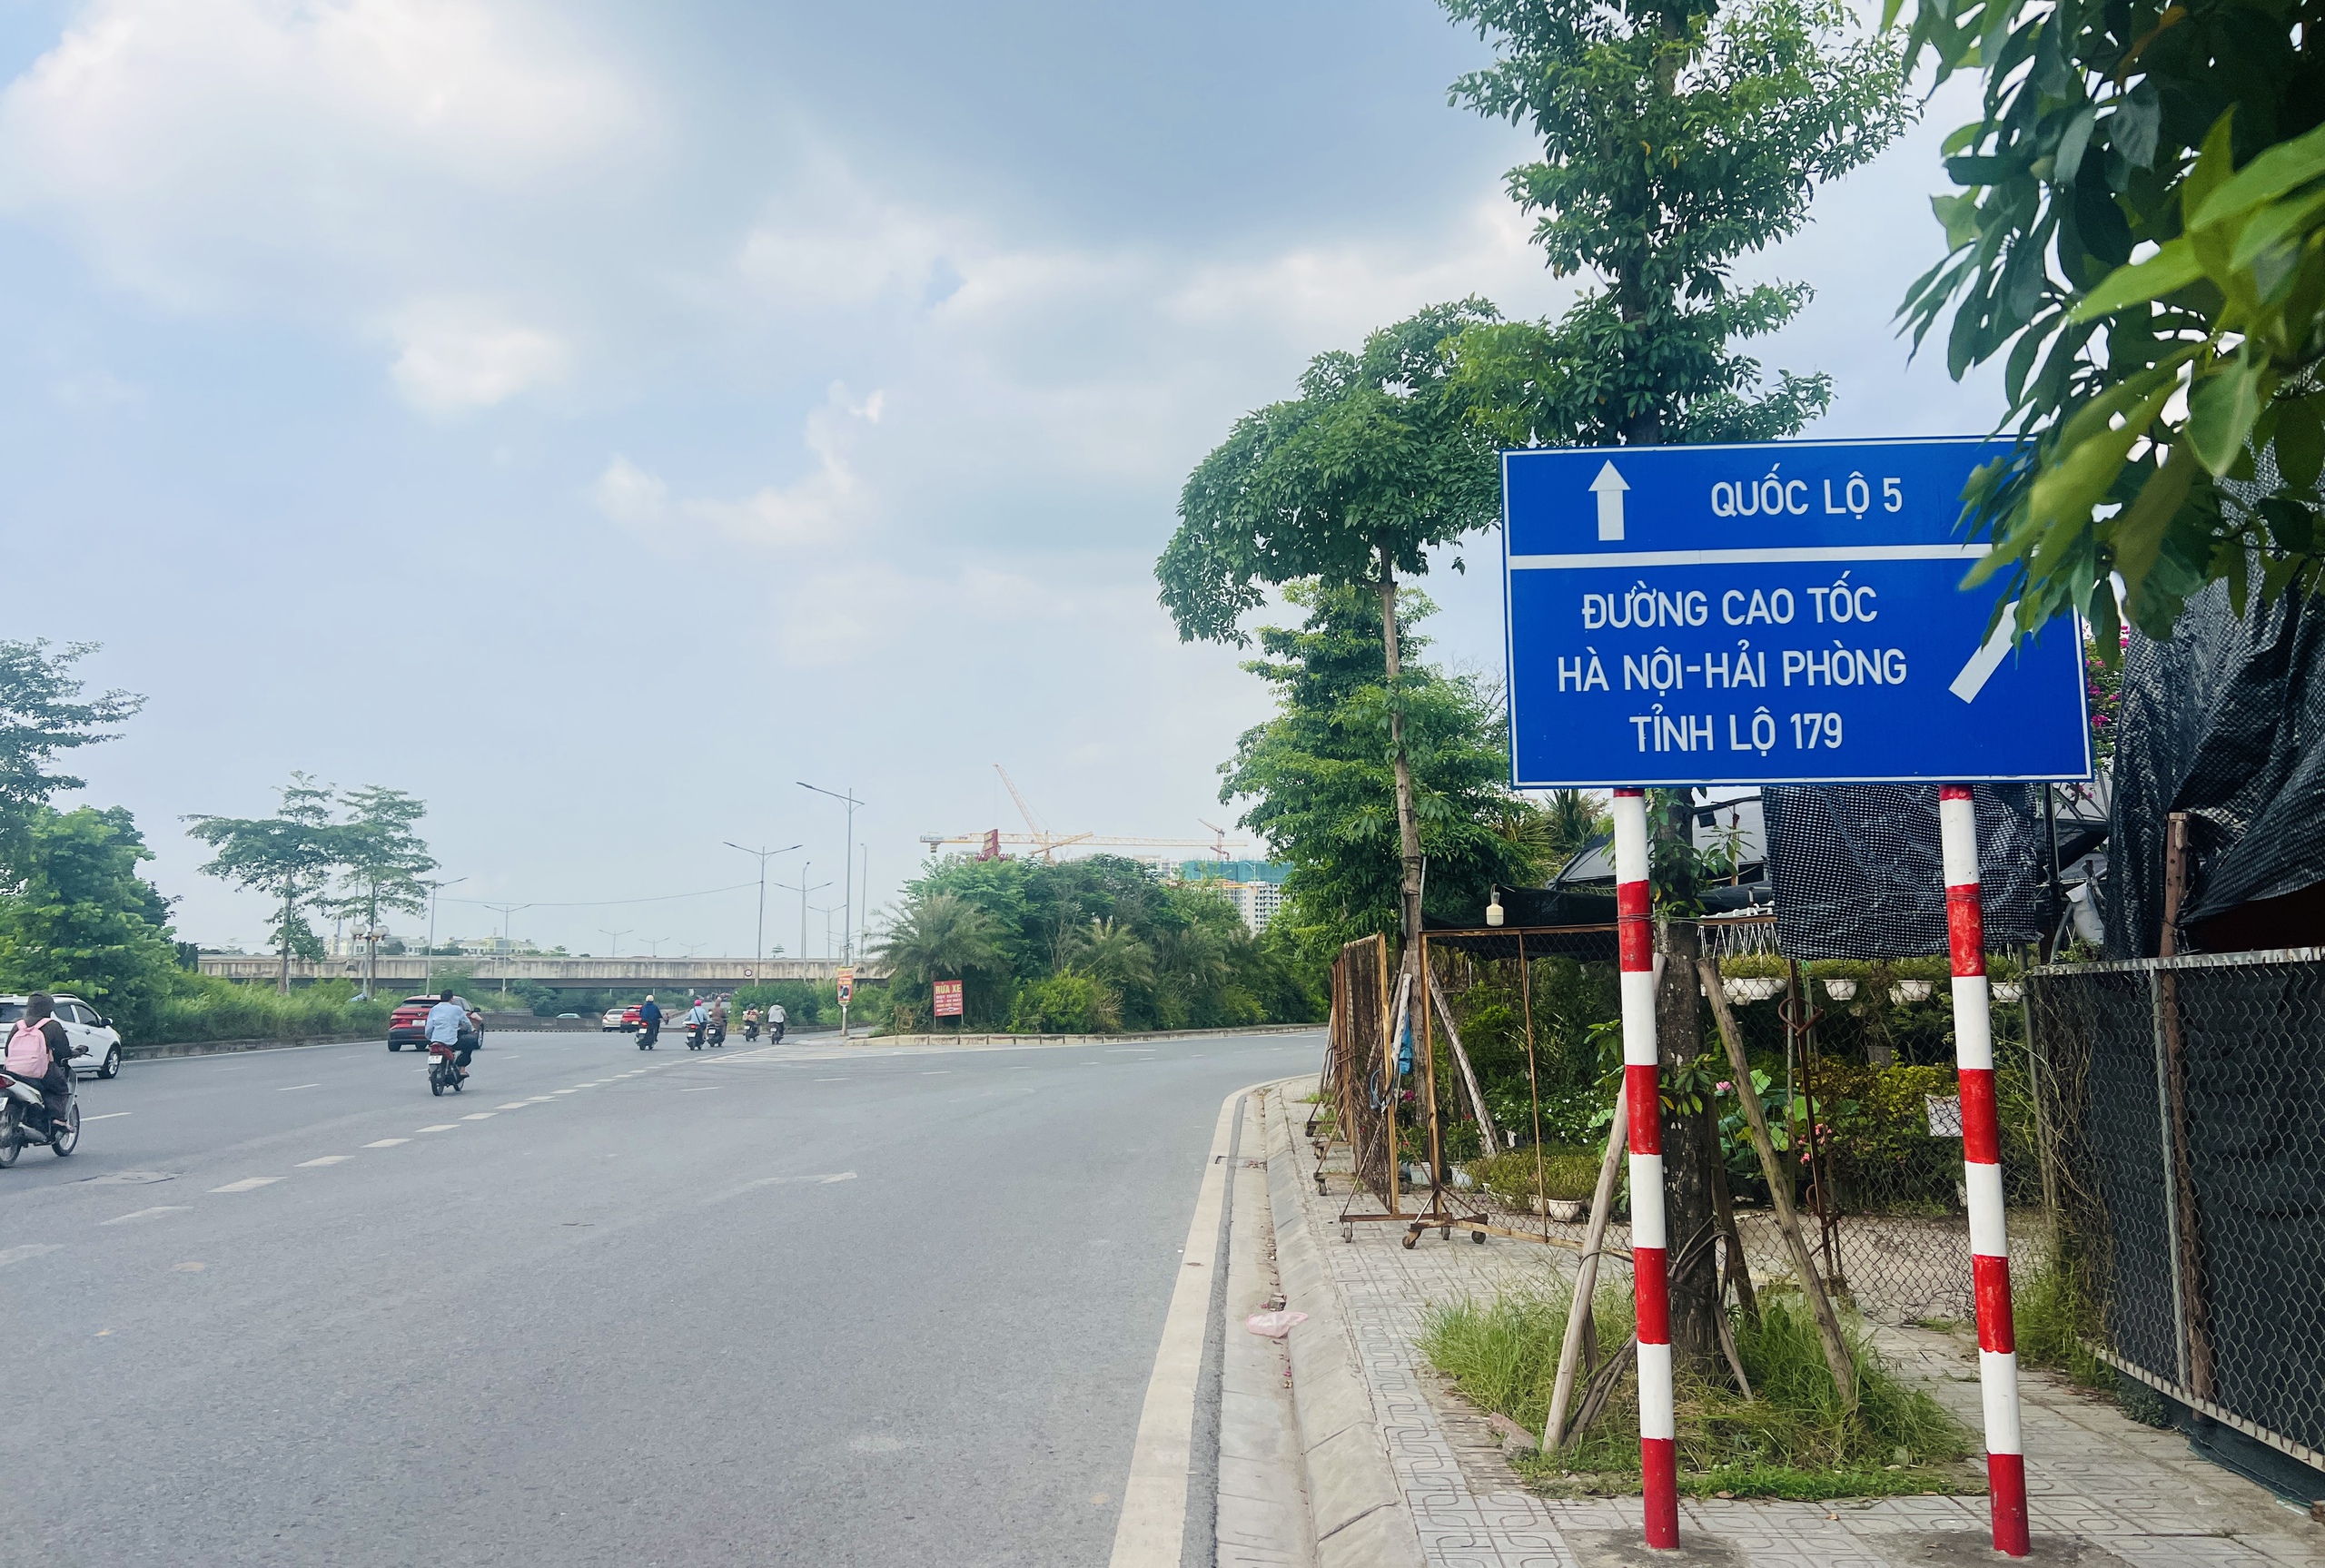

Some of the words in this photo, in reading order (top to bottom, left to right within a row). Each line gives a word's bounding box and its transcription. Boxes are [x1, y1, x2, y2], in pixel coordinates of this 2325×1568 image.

[1711, 462, 1809, 518] QUỐC
[1824, 470, 1870, 520] LỘ
[1883, 478, 1904, 514] 5
[1581, 579, 1708, 629] ĐƯỜNG
[1722, 587, 1796, 626] CAO
[1807, 570, 1878, 624] TỐC
[1558, 646, 1610, 692] HÀ
[1623, 639, 1766, 697] NỘI-HẢI
[1782, 639, 1907, 687] PHÒNG
[1628, 703, 1714, 753] TỈNH
[1729, 705, 1776, 757] LỘ
[1790, 712, 1844, 752] 179
[952, 984, 962, 993] XE
